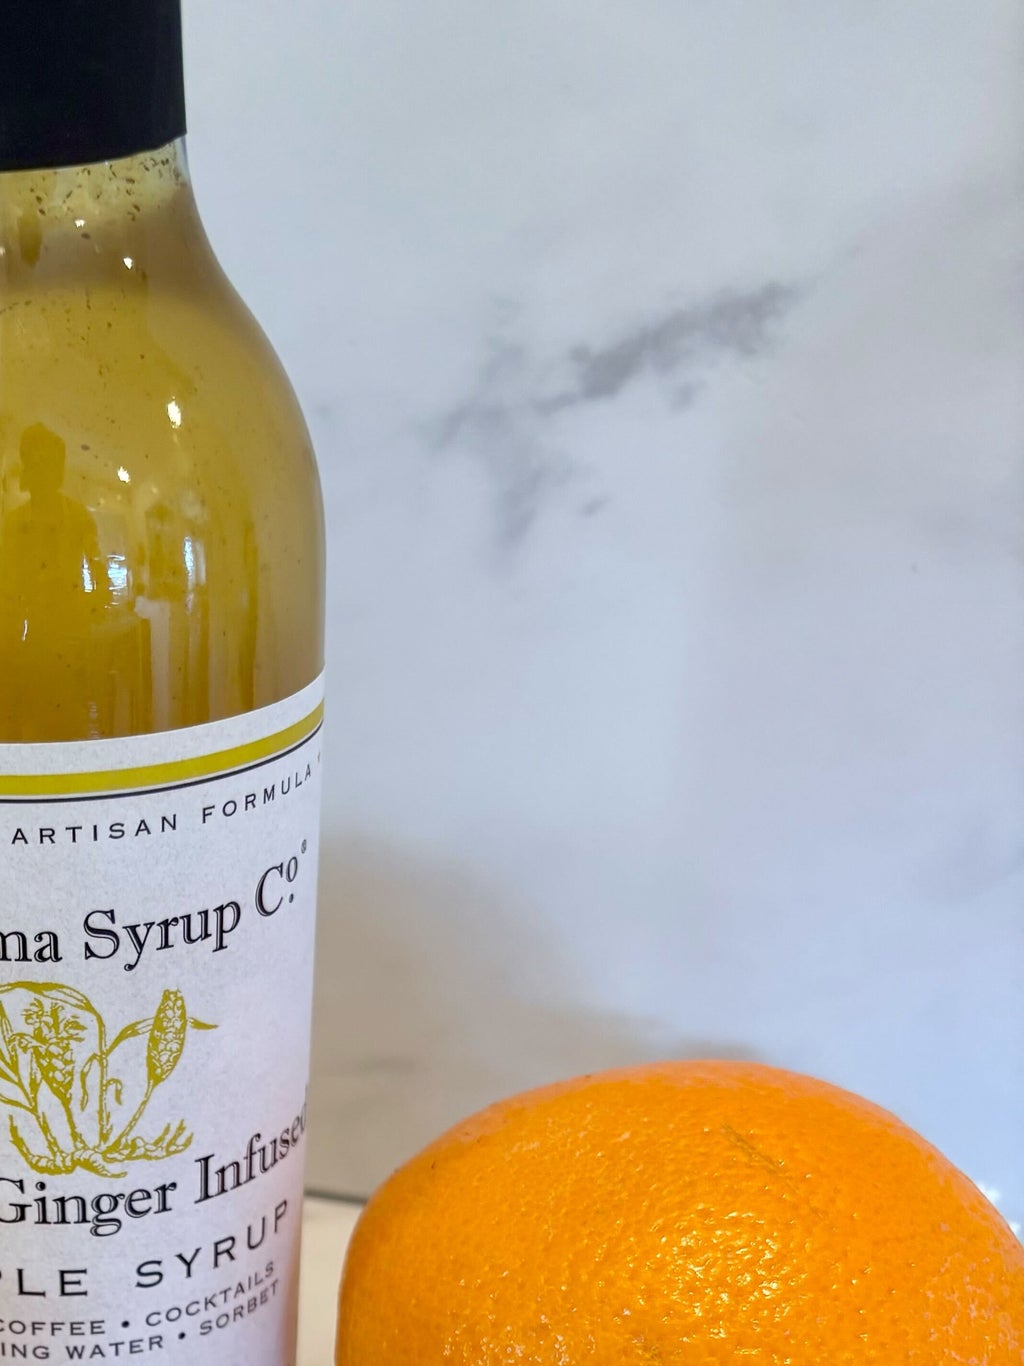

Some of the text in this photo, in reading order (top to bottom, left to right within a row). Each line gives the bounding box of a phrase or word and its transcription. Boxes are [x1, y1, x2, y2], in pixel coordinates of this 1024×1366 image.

[11, 814, 176, 845] ARTISAN
[202, 763, 311, 824] FORMULA
[83, 901, 241, 974] Syrup
[135, 1199, 288, 1288] SYRUP
[65, 1335, 163, 1360] WATER
[200, 1280, 278, 1336] SORBET
[145, 1261, 274, 1327] COCKTAILS
